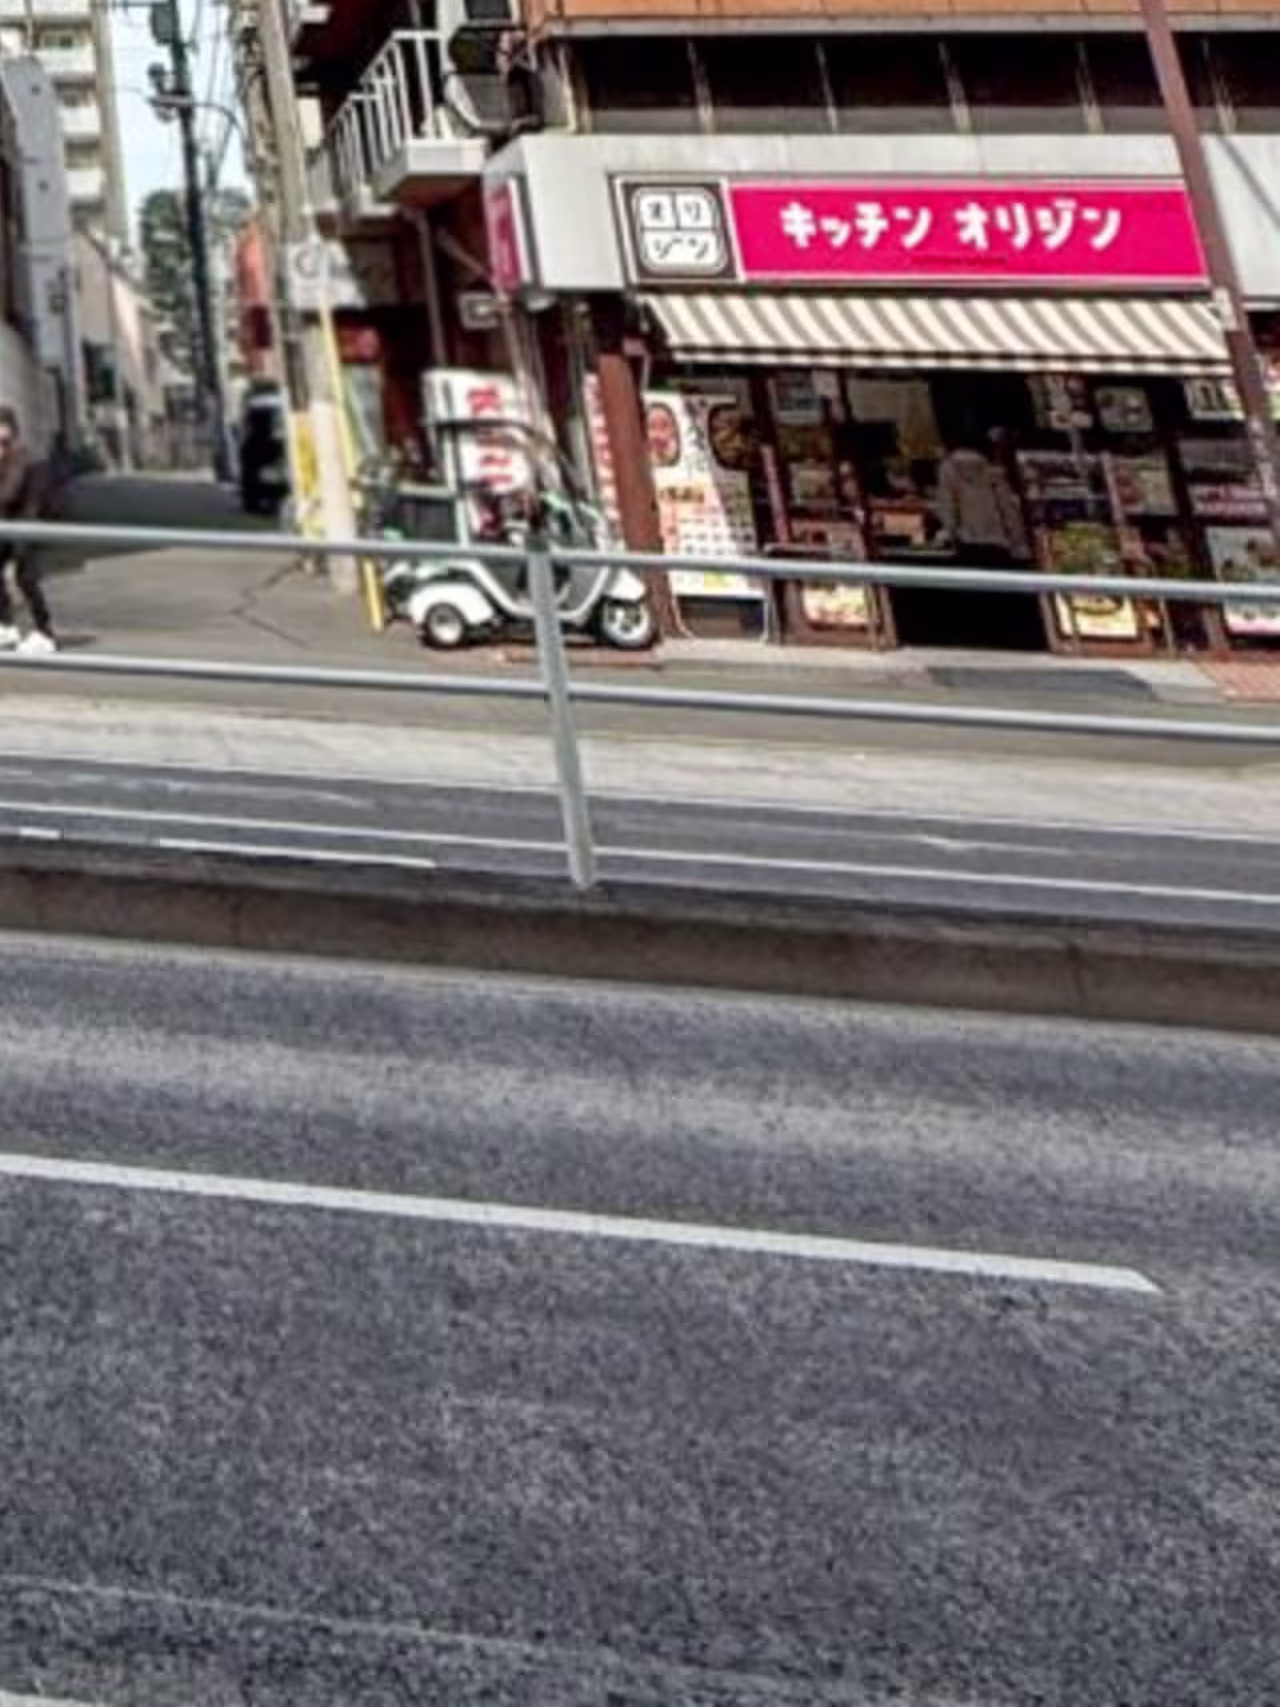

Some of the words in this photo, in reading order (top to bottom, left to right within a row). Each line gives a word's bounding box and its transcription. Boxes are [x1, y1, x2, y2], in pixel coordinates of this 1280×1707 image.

[779, 201, 933, 250] キッチン
[954, 198, 1122, 252] オリジン
